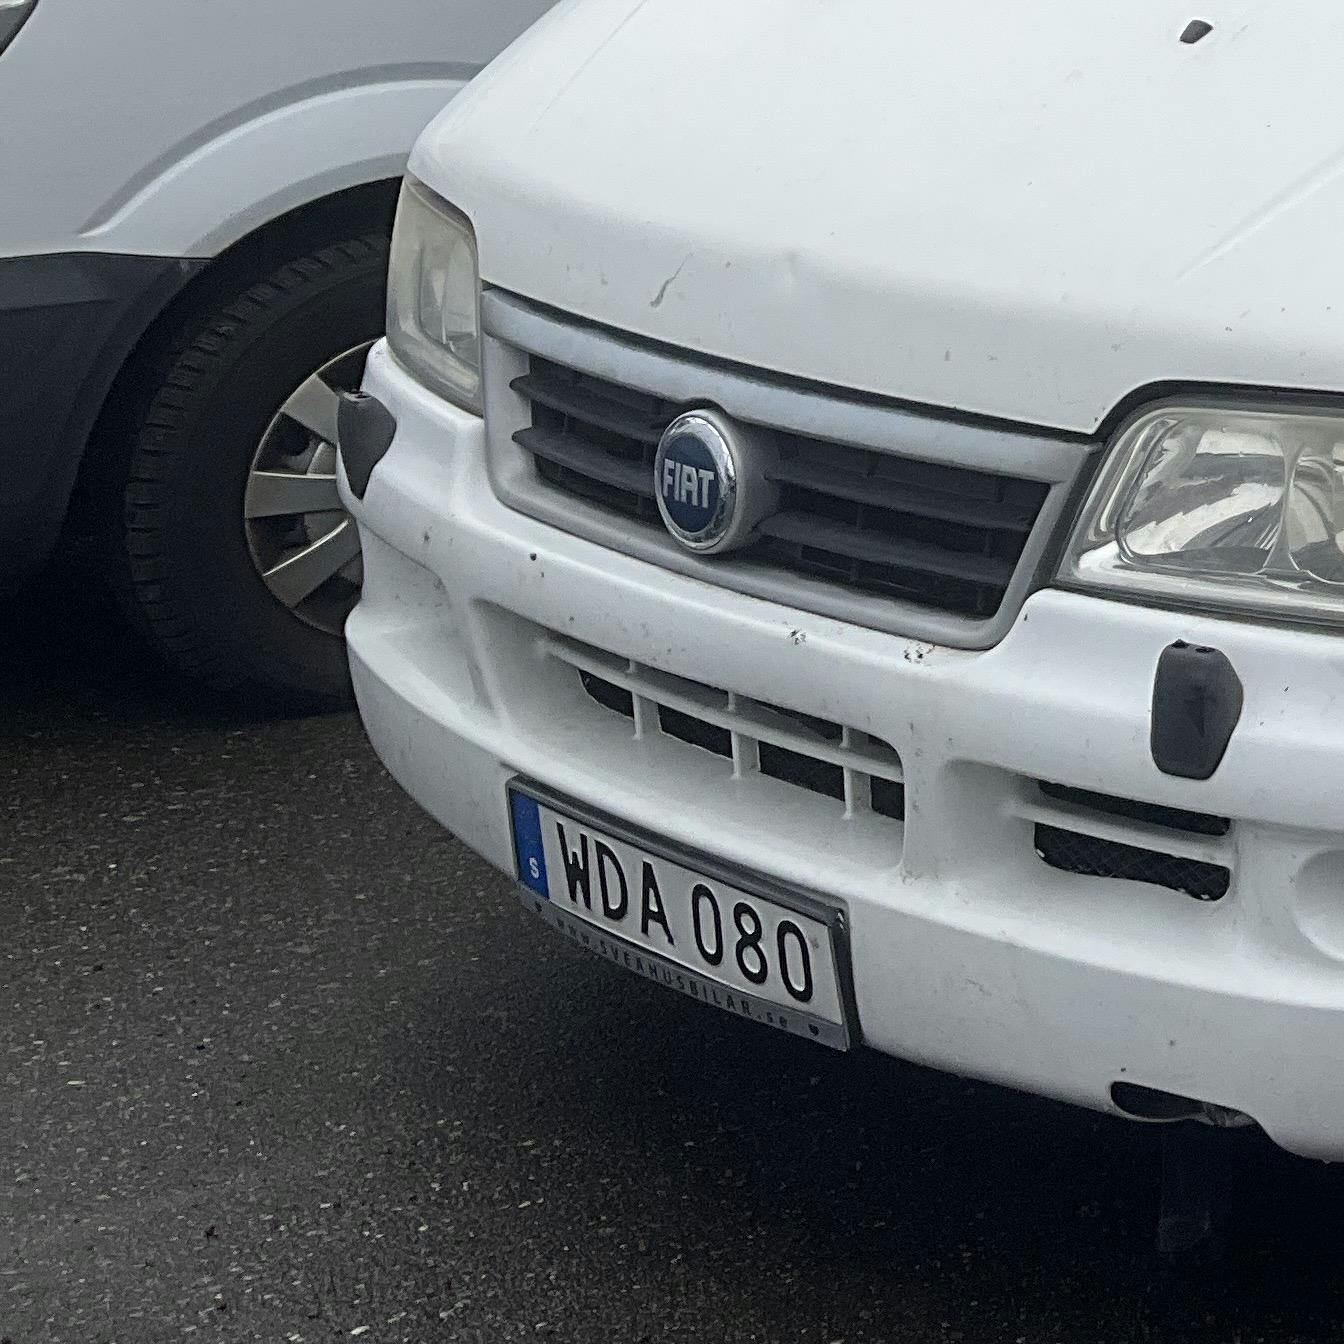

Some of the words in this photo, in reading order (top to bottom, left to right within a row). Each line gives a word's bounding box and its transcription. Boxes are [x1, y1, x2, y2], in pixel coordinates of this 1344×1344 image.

[662, 458, 714, 508] FIAT
[529, 857, 540, 879] S
[556, 822, 675, 946] WDA
[691, 883, 814, 1003] 080
